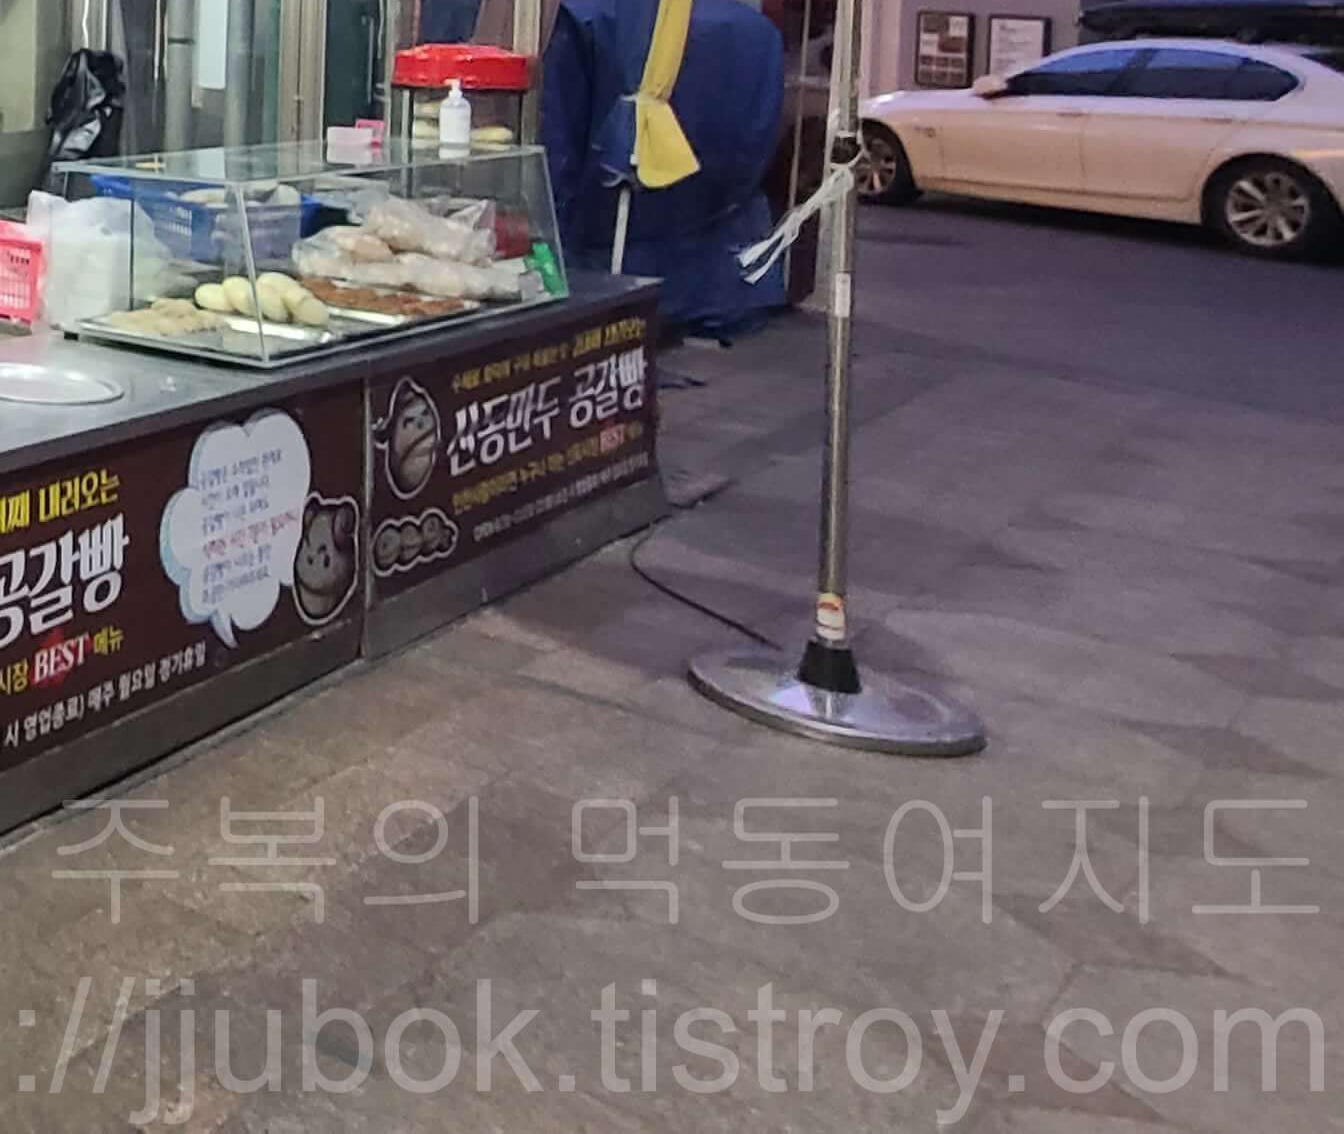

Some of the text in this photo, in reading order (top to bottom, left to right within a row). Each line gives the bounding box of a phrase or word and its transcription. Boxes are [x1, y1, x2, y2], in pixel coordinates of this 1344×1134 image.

[447, 376, 561, 477] 산동만두
[569, 346, 648, 429] 공갈빵
[38, 469, 120, 524] 내려오는
[34, 632, 89, 684] BEST
[94, 625, 124, 656] 메뉴
[4, 719, 19, 748] 시
